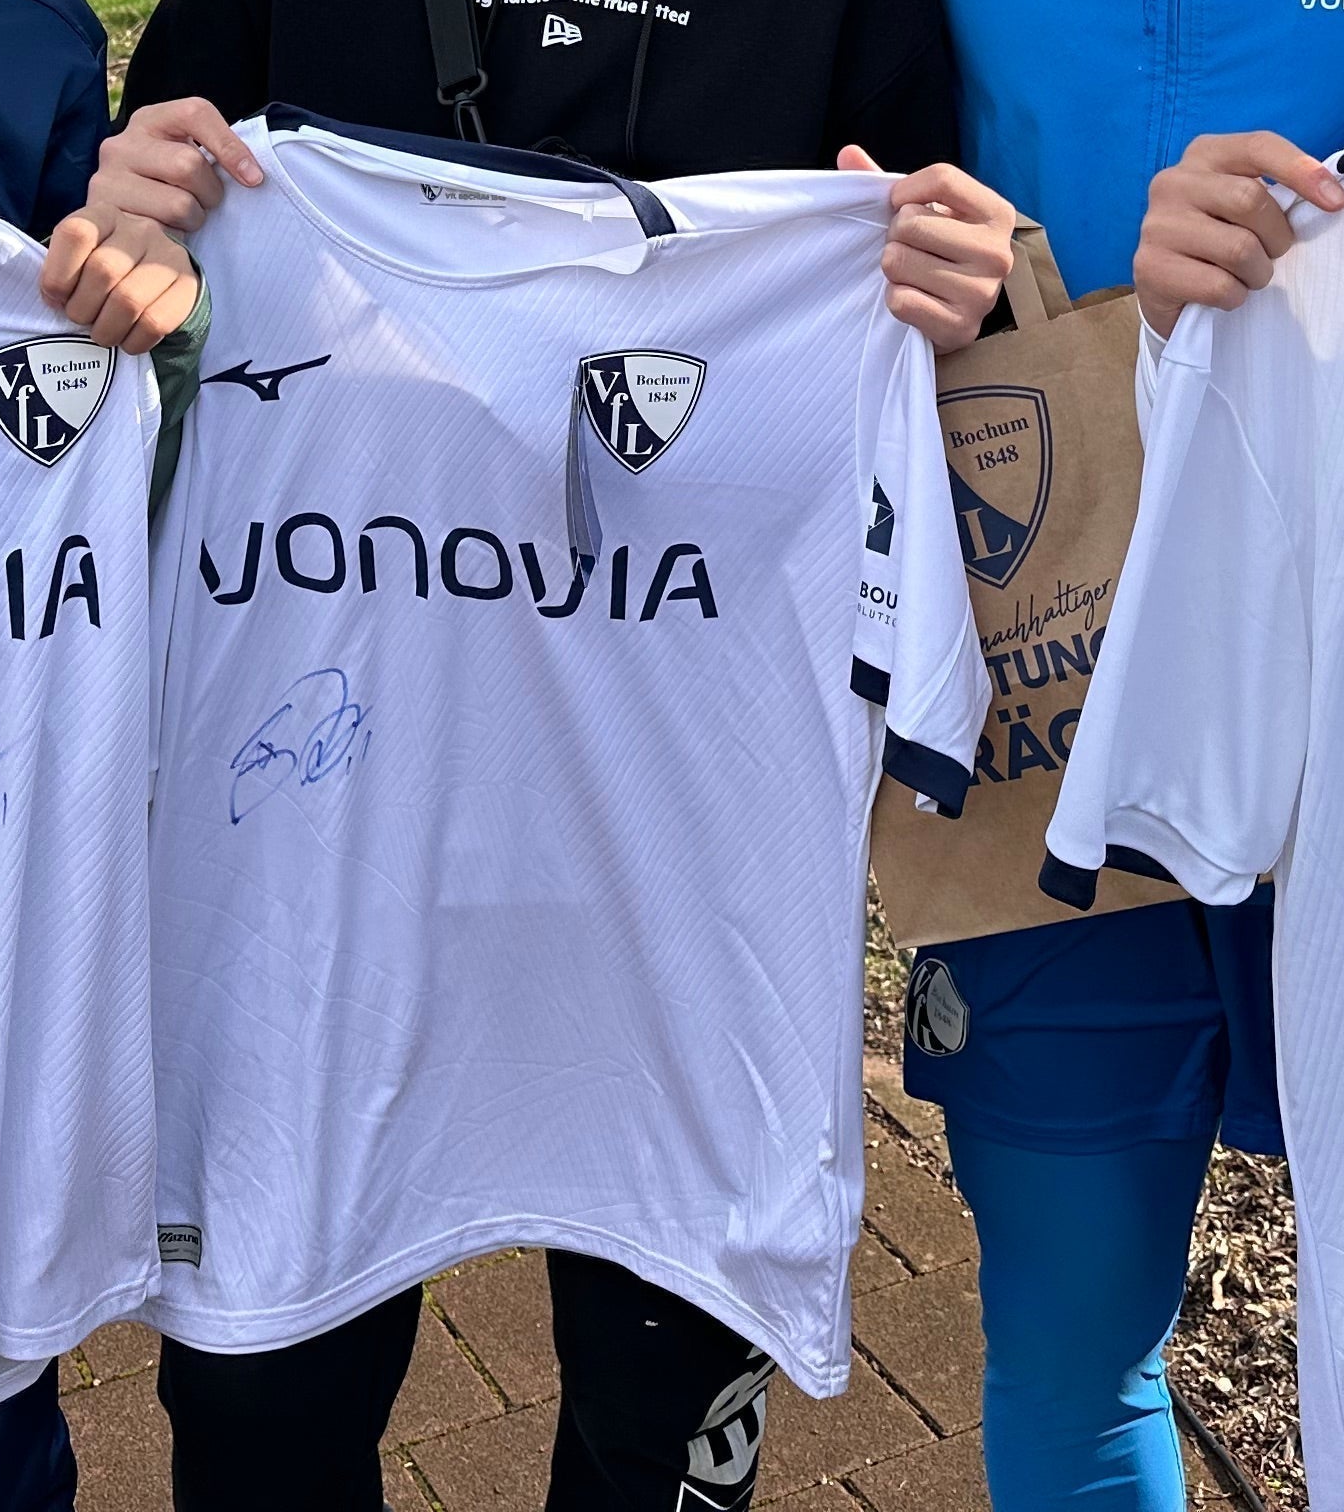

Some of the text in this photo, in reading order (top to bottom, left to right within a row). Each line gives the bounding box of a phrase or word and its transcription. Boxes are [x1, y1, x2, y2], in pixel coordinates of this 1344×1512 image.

[42, 359, 101, 375] Bochum
[56, 376, 88, 392] 1848
[636, 374, 691, 386] Bochum
[647, 391, 678, 403] 1848
[588, 368, 653, 455] VfL
[950, 413, 1030, 450] Bochum
[974, 443, 1020, 472] 1848
[199, 511, 719, 623] VONOVIA
